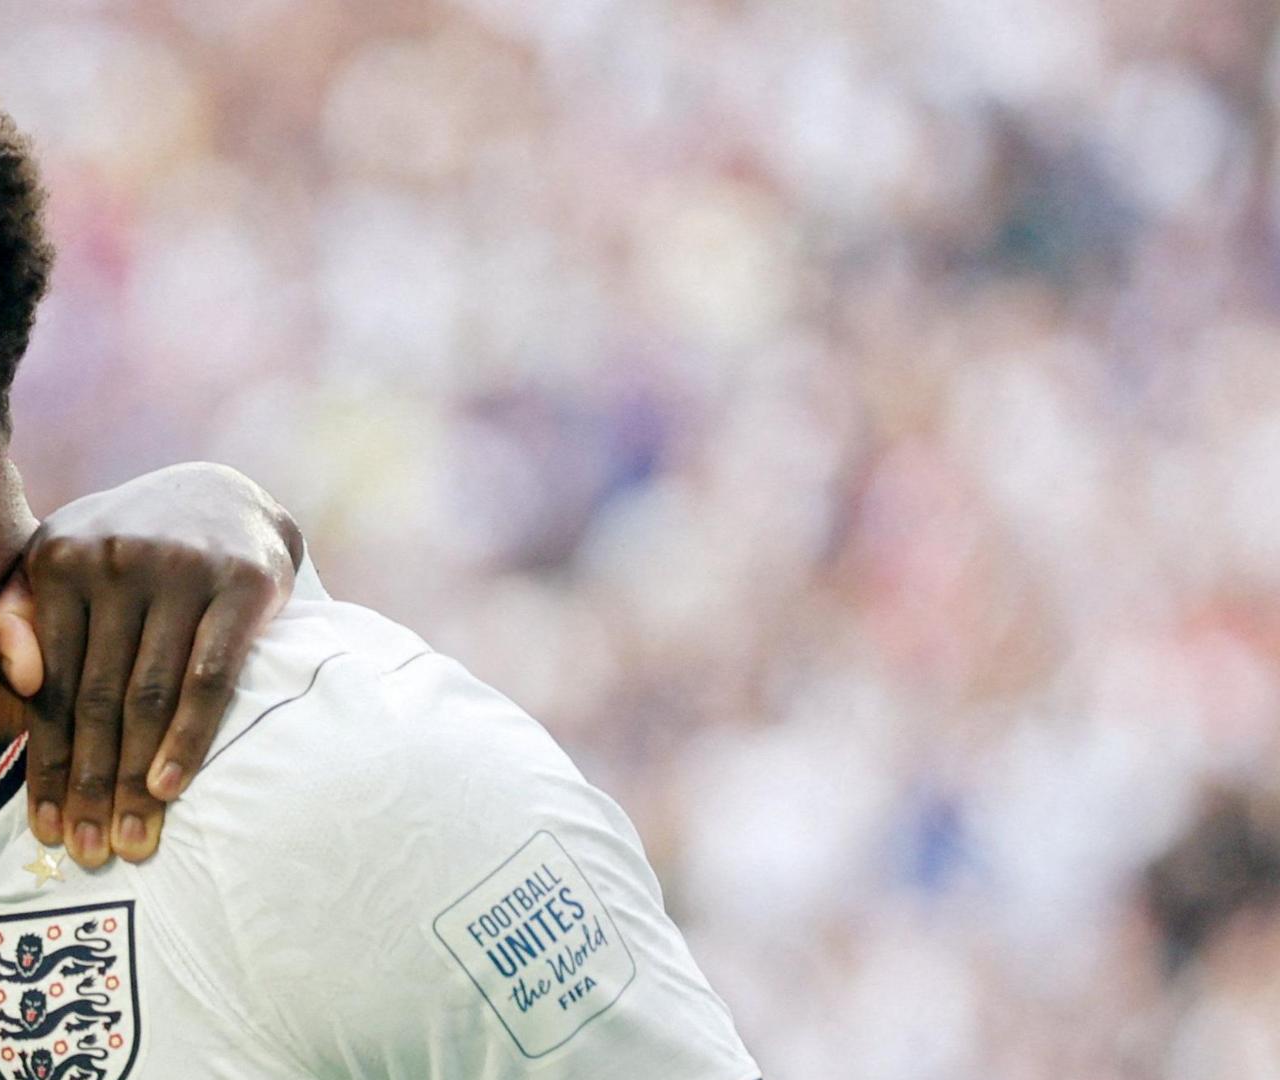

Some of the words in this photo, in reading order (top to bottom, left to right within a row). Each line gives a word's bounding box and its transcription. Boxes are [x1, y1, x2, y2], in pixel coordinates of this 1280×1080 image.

[467, 863, 562, 947] FOOTBALL
[486, 887, 585, 977] UNITES
[508, 968, 551, 1013] the
[546, 915, 608, 984] World
[558, 976, 597, 1010] FIFA
